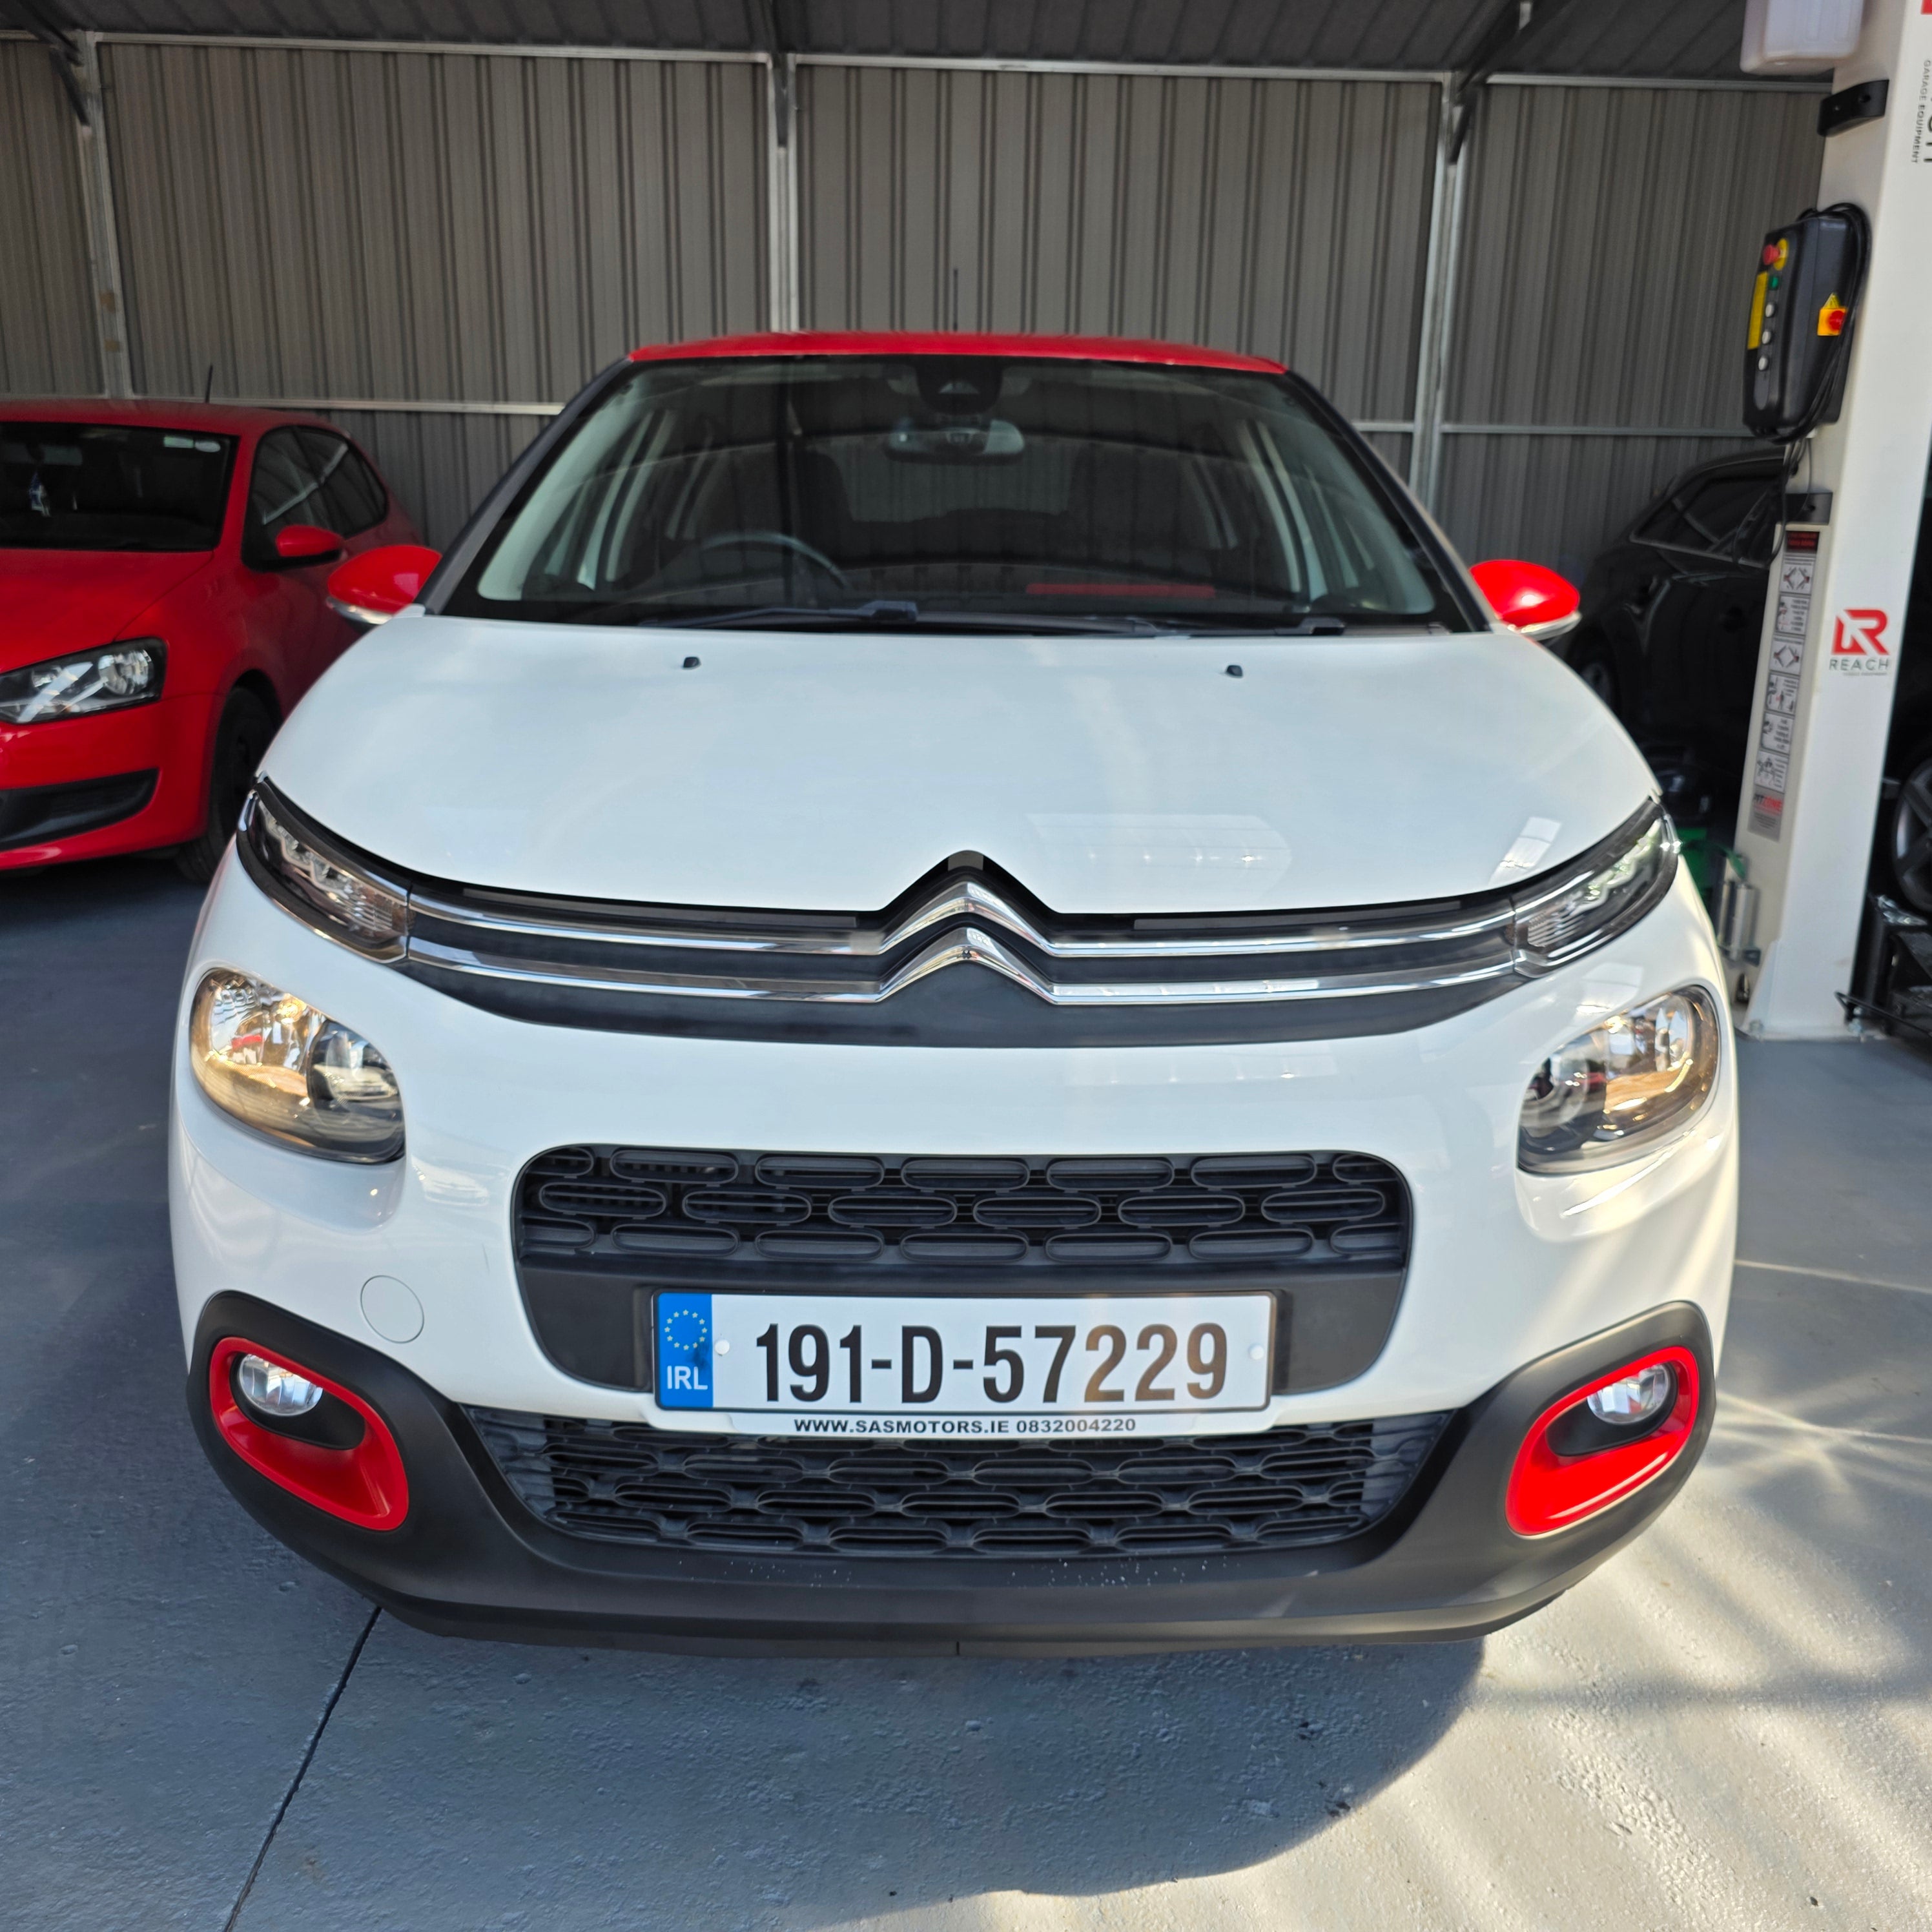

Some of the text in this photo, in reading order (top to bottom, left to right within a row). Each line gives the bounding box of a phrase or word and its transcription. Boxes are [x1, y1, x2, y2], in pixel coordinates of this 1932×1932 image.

[1919, 60, 1931, 101] GARAGE
[1911, 104, 1926, 163] EQUIPMENT
[1829, 659, 1889, 671] REACH
[666, 1365, 708, 1390] IRL
[756, 1322, 1228, 1403] 191-D-57229
[794, 1419, 1136, 1434] WWW.SASMOTORS.IE 0832004220
